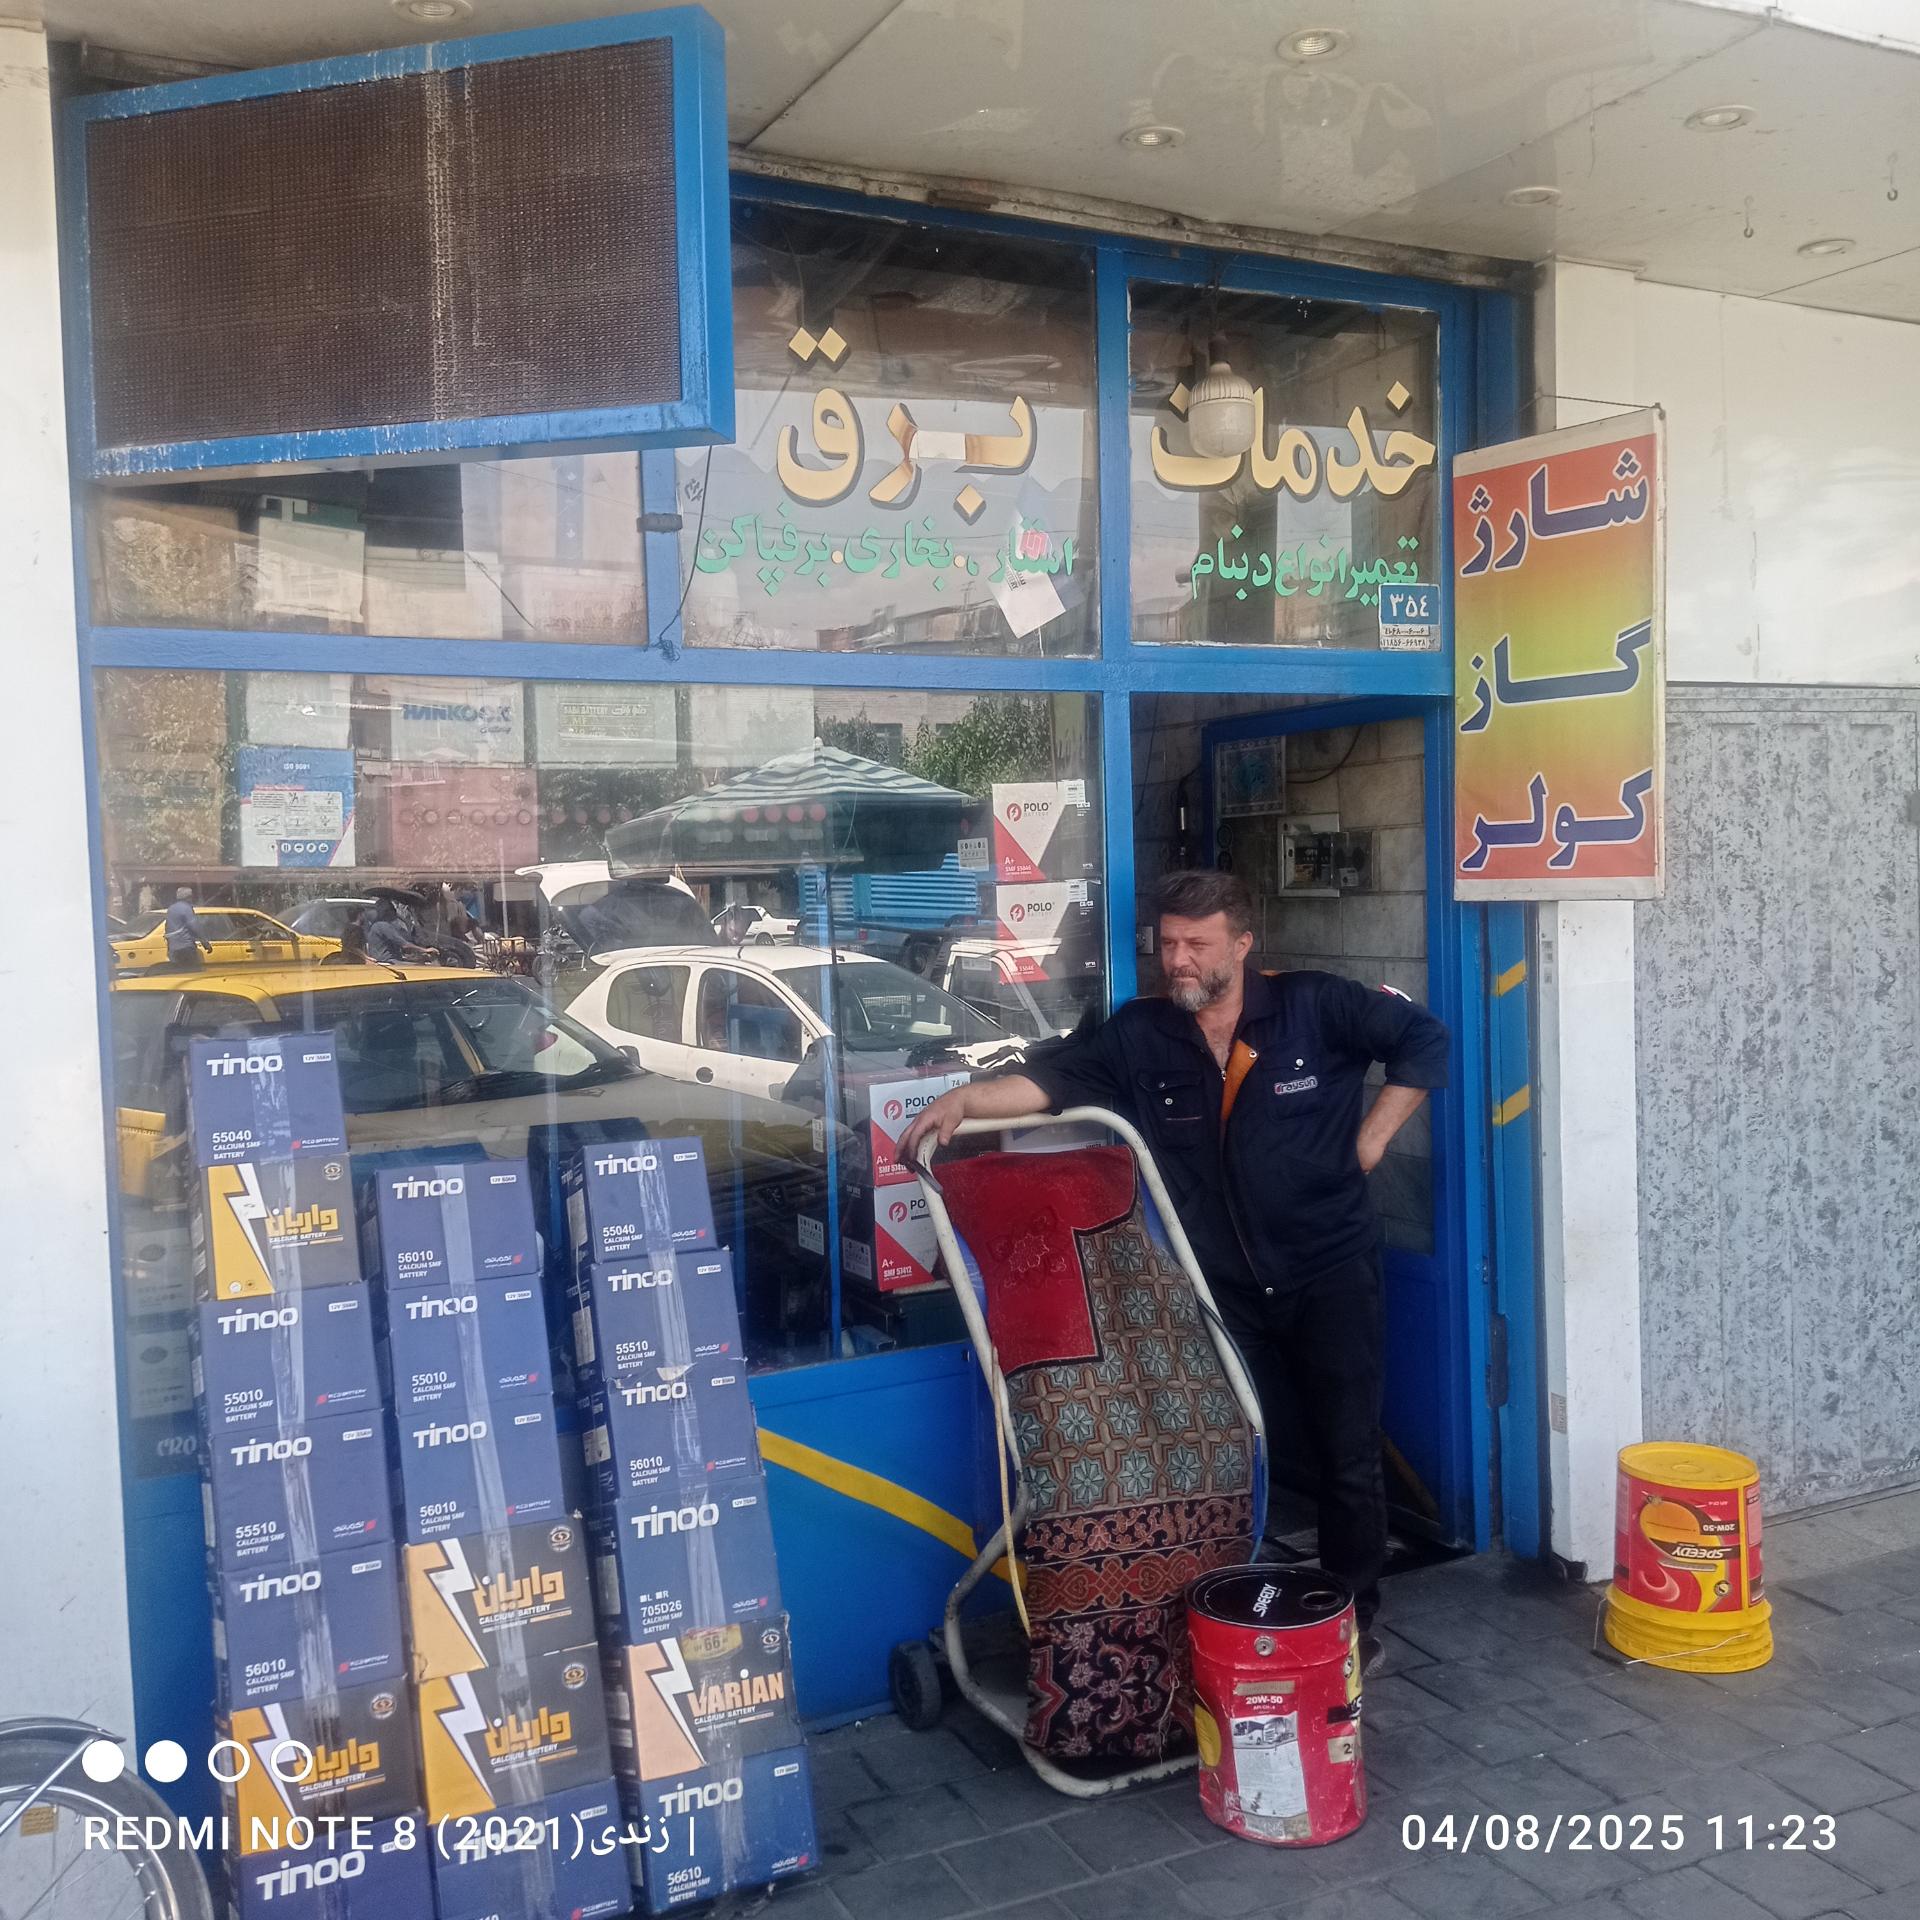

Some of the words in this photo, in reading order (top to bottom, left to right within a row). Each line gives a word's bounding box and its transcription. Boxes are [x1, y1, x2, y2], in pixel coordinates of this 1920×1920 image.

[777, 327, 1034, 517] برق
[1152, 381, 1437, 496] خدمات
[1460, 447, 1651, 577] شارژ
[843, 515, 952, 592] بخاری
[1345, 535, 1419, 606] تعمیر
[1460, 618, 1652, 733] گاز
[1024, 802, 1049, 811] POLO
[1460, 768, 1652, 871] کولر
[1004, 856, 1014, 864] A+
[1027, 902, 1052, 911] POLO
[207, 1053, 282, 1076] Tinoo
[905, 1095, 936, 1107] POLO
[212, 1130, 252, 1142] 55040
[213, 1142, 245, 1150] CALCIUM
[214, 1151, 245, 1159] BATTERY
[876, 1155, 888, 1163] A+
[594, 1154, 656, 1176] Tinoo
[392, 1175, 463, 1198] Tinoo
[910, 1198, 927, 1210] PO
[603, 1224, 636, 1236] 55040
[269, 1234, 298, 1243] CALCIUM
[299, 1231, 327, 1239] BATTERY
[604, 1235, 630, 1243] CALCIUM
[605, 1243, 630, 1251] BATTERY
[398, 1251, 434, 1262] 56010
[881, 1258, 894, 1267] A+
[399, 1262, 424, 1270] CALCIUM
[399, 1270, 427, 1278] BATTERY
[608, 1269, 672, 1291] Tinoo
[405, 1295, 477, 1319] Tinoo
[218, 1307, 297, 1334] Tinoo
[616, 1340, 649, 1353] 55510
[617, 1352, 643, 1361] CALCIUM
[618, 1360, 643, 1369] BATTERY
[412, 1371, 447, 1386] 55010
[412, 1384, 441, 1393] CALCIUM
[621, 1381, 686, 1405] Tinoo
[224, 1389, 264, 1405] 55010
[413, 1392, 442, 1402] BATTERY
[225, 1401, 257, 1412] CALCIUM
[226, 1411, 257, 1423] BATTERY
[413, 1420, 486, 1448] Tinoo
[231, 1436, 311, 1465] Tinoo
[630, 1456, 663, 1470] 56010
[631, 1468, 657, 1477] CALCIUM
[632, 1476, 658, 1486] BATTERY
[420, 1501, 457, 1516] 56010
[420, 1515, 450, 1525] CALCIUM
[631, 1503, 718, 1537] Tinoo
[235, 1521, 277, 1538] 55510
[422, 1524, 451, 1534] BATTERY
[1703, 1523, 1735, 1531] 20W-50
[236, 1534, 269, 1545] CALCIUM
[237, 1545, 269, 1556] BATTERY
[1672, 1546, 1733, 1558] SPEEDY
[240, 1571, 321, 1601] Tinoo
[1253, 1583, 1278, 1616] SPEEDY
[479, 1610, 515, 1624] CALCIUM
[518, 1603, 551, 1616] BATTERY
[640, 1600, 683, 1617] 705D26
[642, 1614, 670, 1625] CALCIUM
[644, 1623, 670, 1633] BATTERY
[245, 1659, 287, 1676] 56010
[246, 1672, 279, 1684] CALCIUM
[247, 1683, 279, 1695] BATTERY
[688, 1669, 785, 1716] VARIAN
[1245, 1695, 1283, 1704] 20W-50
[694, 1711, 726, 1724] CALCIUM
[727, 1705, 756, 1717] BATTERY
[490, 1751, 525, 1765] CALCIUM
[528, 1743, 558, 1755] BATTERY
[300, 1779, 333, 1792] CALCIUM
[335, 1772, 366, 1785] BATTERY
[659, 1777, 742, 1815] Tinoo
[256, 1850, 365, 1899] Tinoo
[668, 1879, 697, 1893] CALCIUM
[669, 1889, 697, 1902] BATTERY
